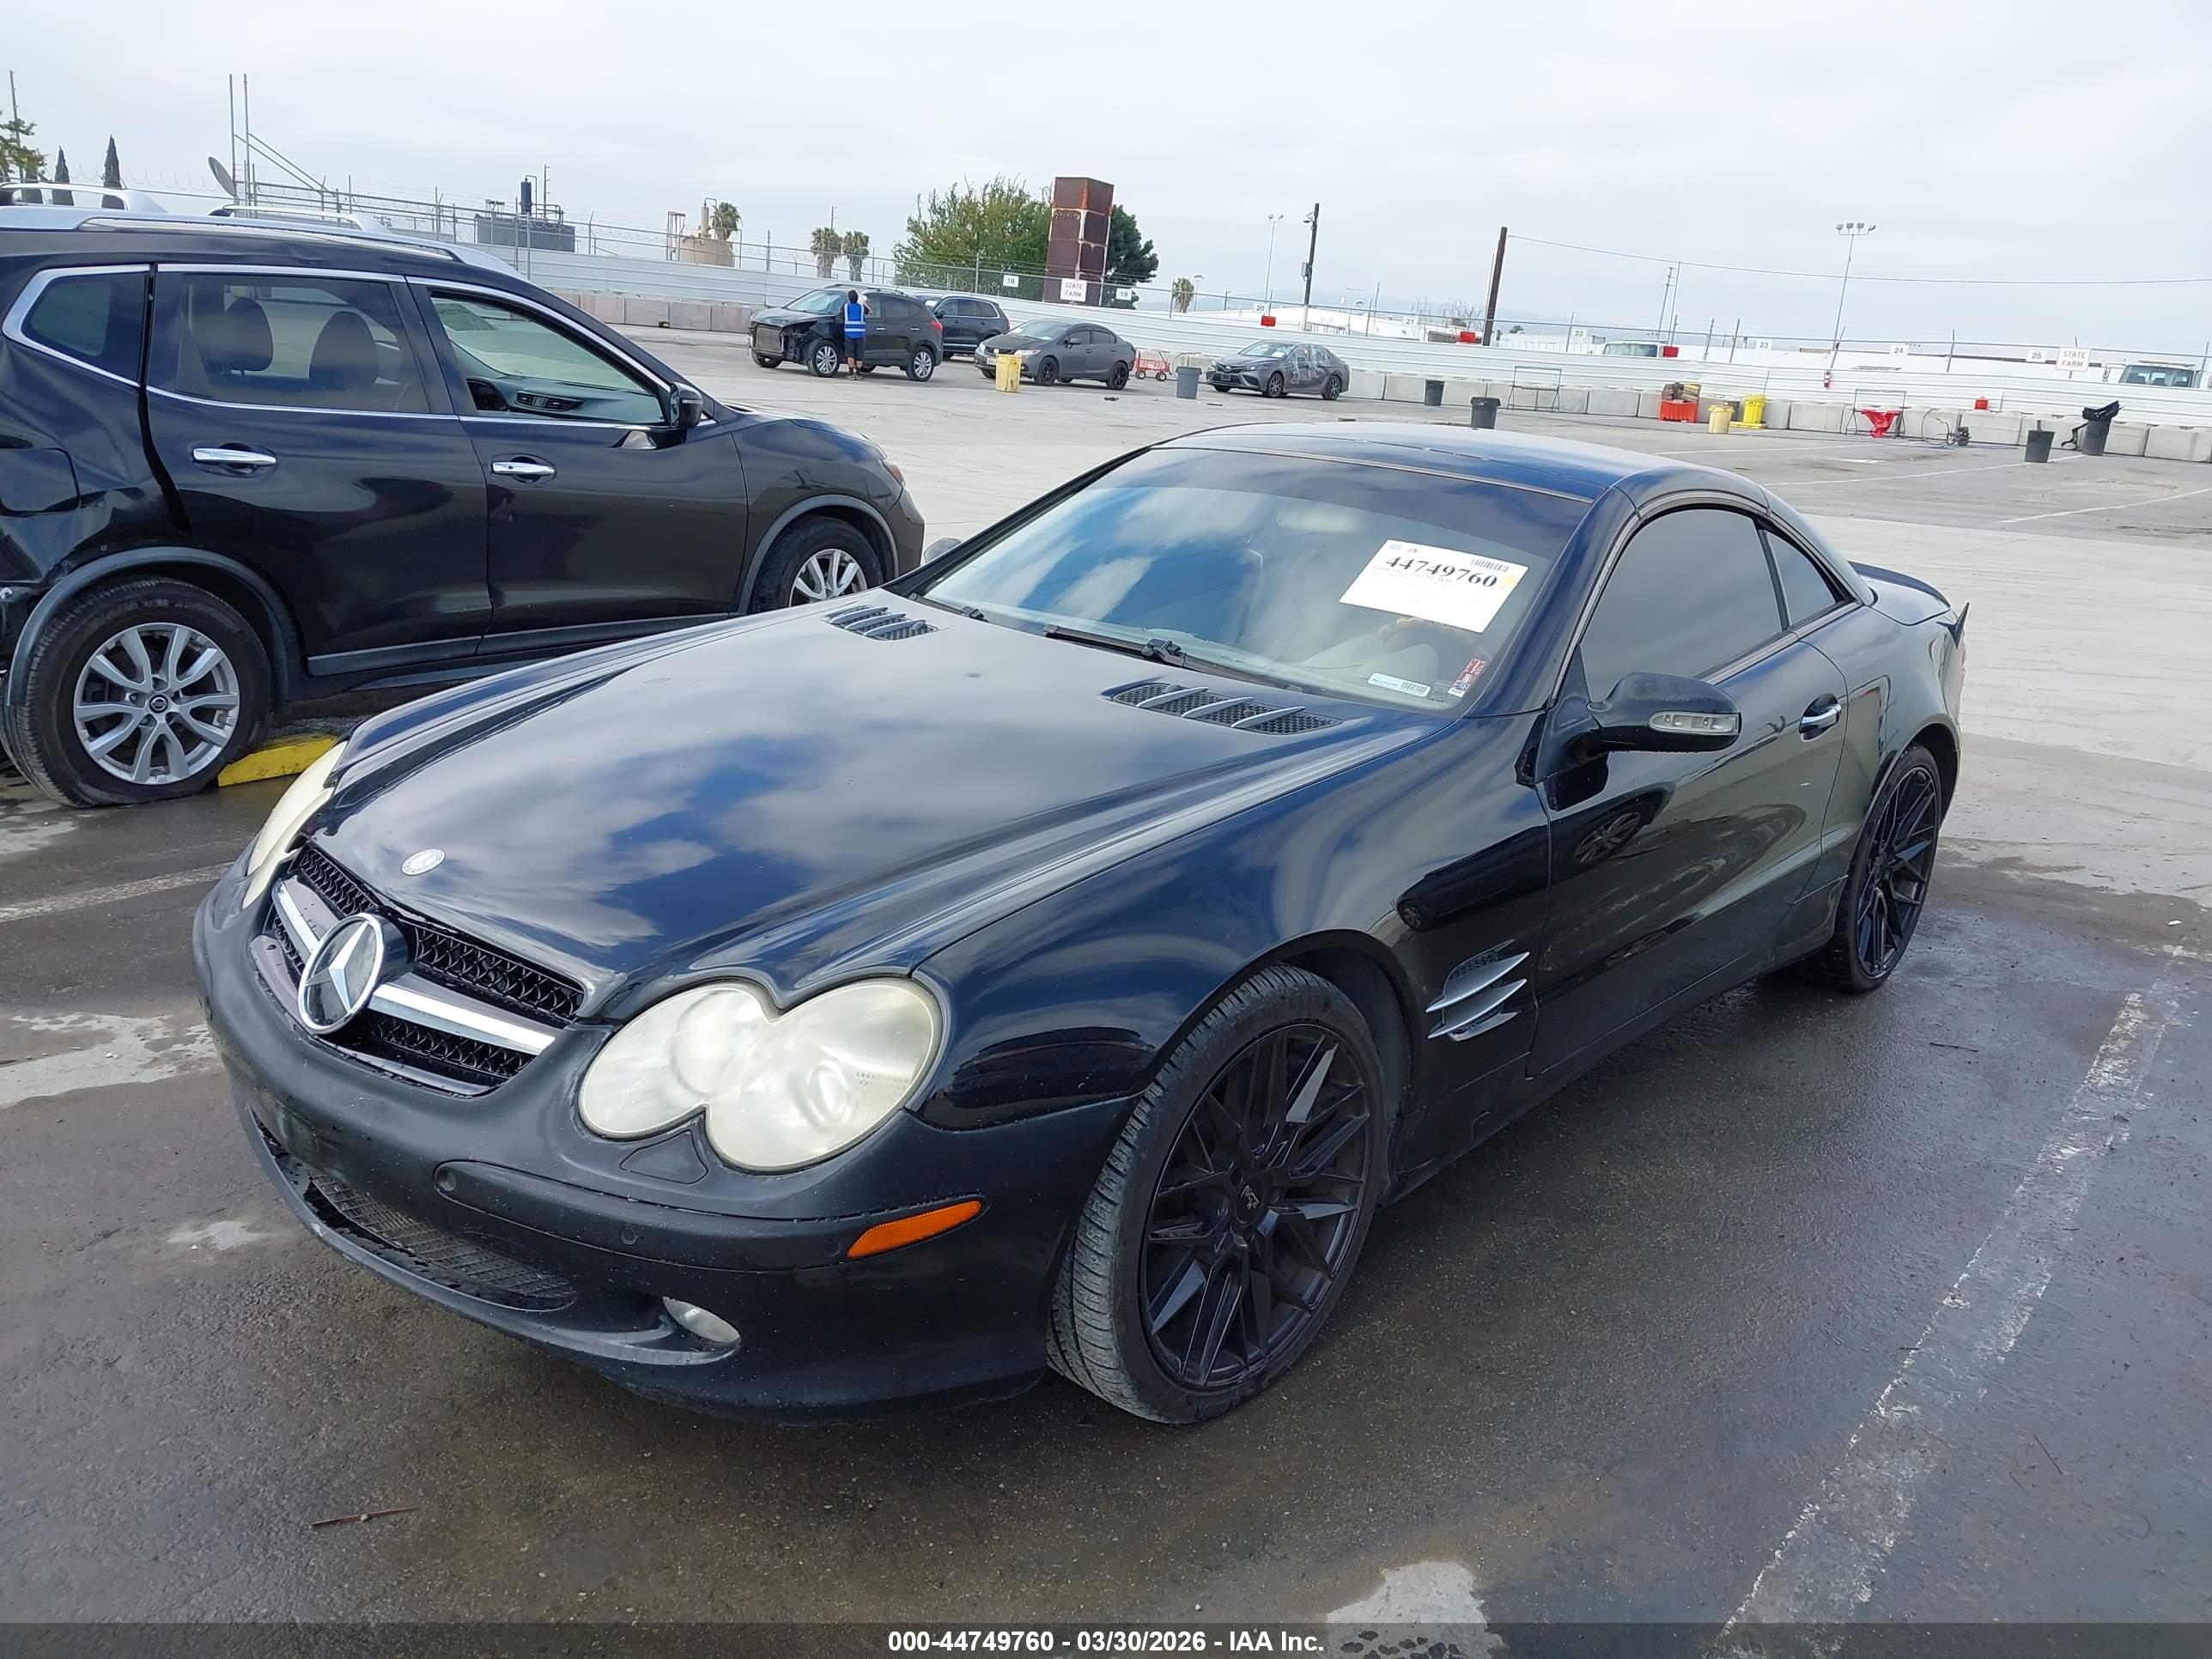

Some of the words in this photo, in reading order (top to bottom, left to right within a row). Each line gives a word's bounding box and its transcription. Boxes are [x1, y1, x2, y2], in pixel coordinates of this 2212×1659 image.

[1065, 282, 1084, 290] STATE
[1064, 289, 1082, 298] FARM
[2063, 350, 2086, 359] STATE
[1386, 556, 1498, 587] 44749760
